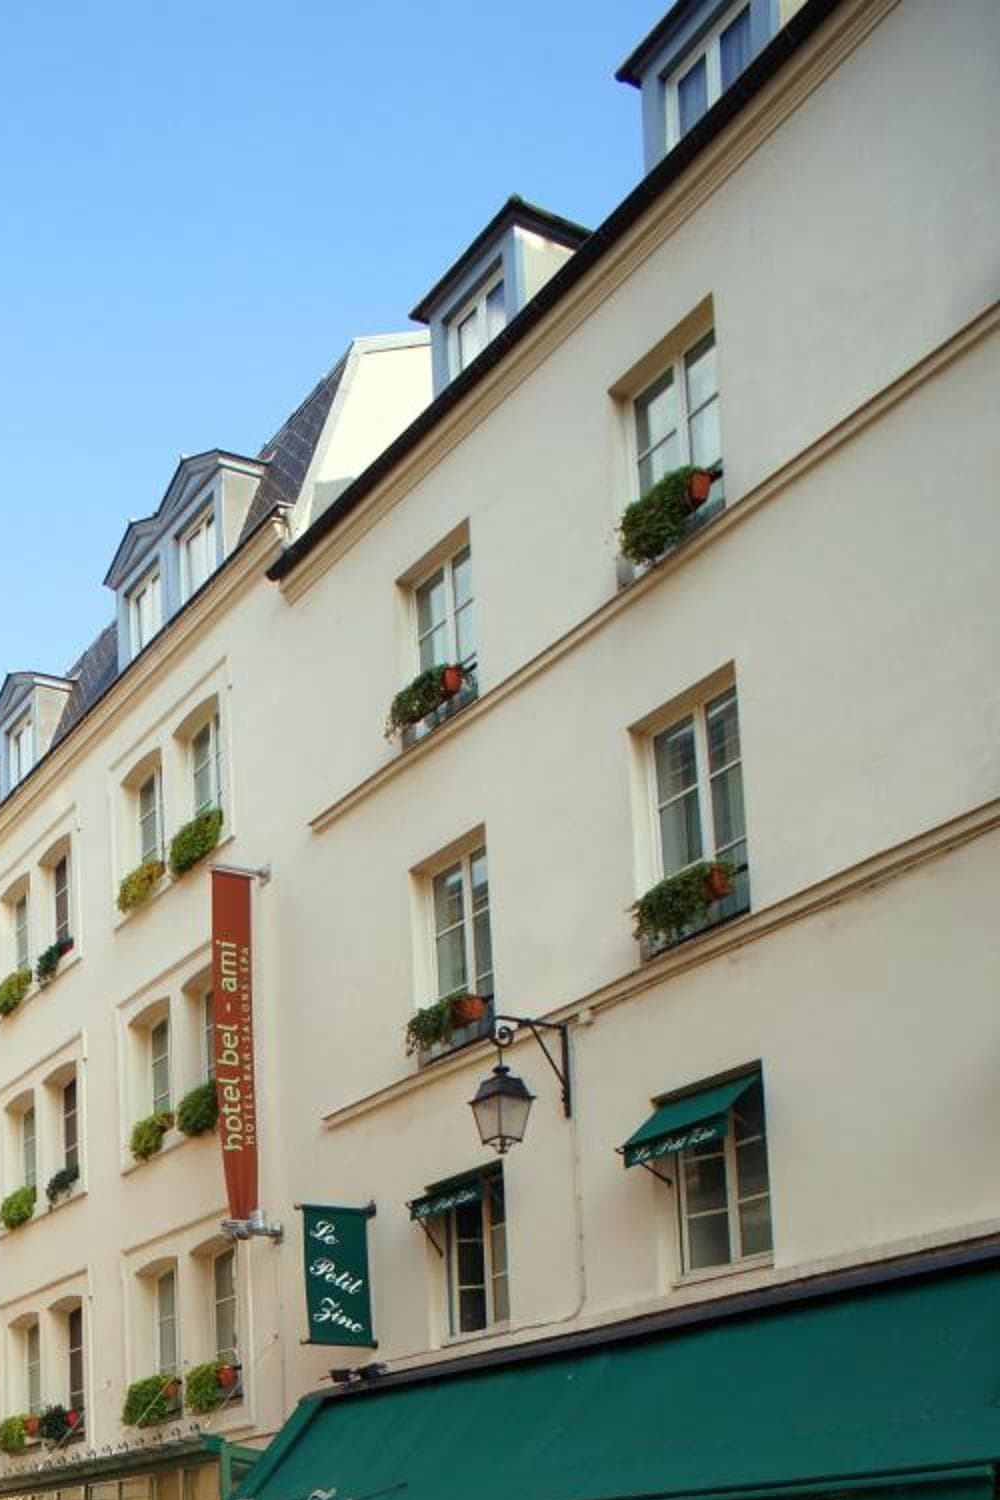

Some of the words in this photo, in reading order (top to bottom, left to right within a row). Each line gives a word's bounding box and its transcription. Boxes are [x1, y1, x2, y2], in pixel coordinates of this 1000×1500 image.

[215, 939, 237, 993] ami
[216, 1023, 240, 1066] bel
[218, 1076, 243, 1152] hotel
[309, 1220, 340, 1245] Le
[309, 1257, 363, 1295] Petit
[313, 1297, 365, 1333] Zinc
